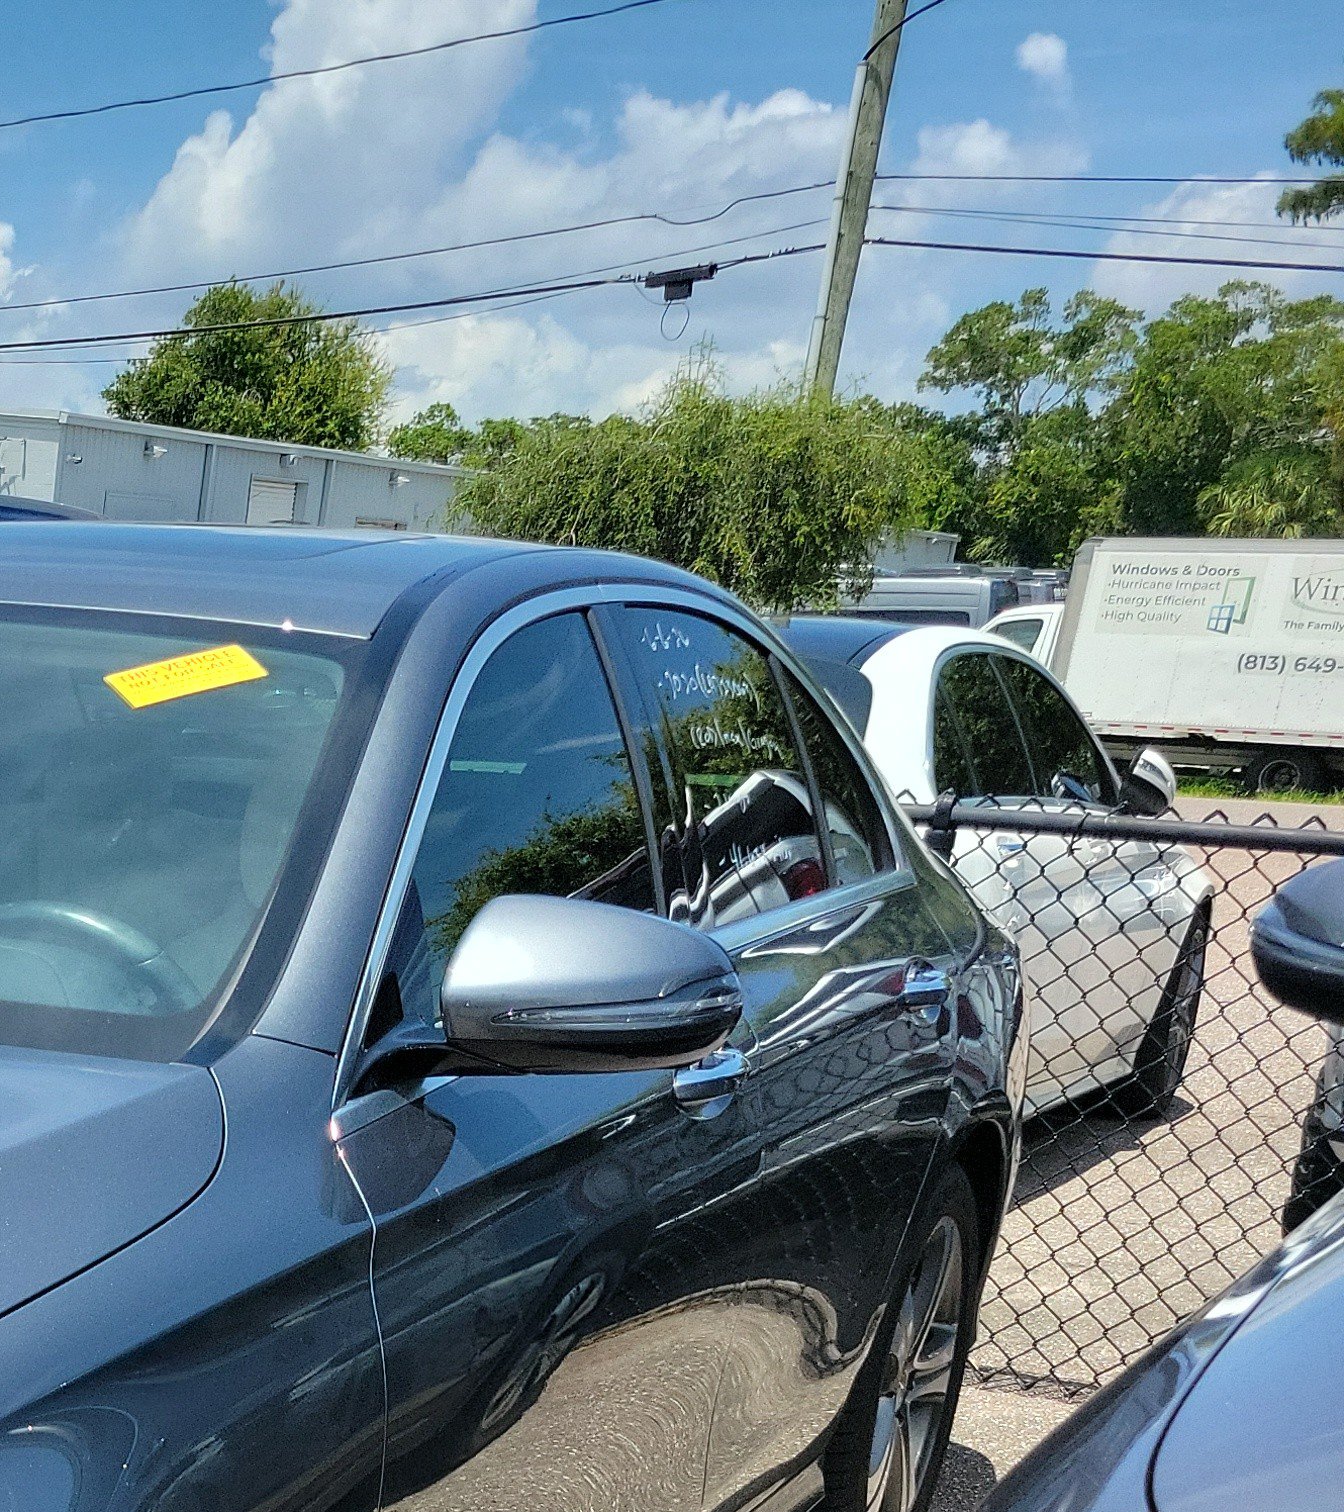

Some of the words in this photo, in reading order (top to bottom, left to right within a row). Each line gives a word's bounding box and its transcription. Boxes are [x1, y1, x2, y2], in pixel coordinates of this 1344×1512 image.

[1112, 563, 1179, 576] Windows
[1182, 564, 1192, 576] &
[1196, 563, 1241, 577] Doors
[1111, 578, 1173, 590] Hurricane
[1175, 579, 1221, 591] Impact
[1108, 594, 1152, 606] Energy
[1154, 595, 1206, 606] Efficient
[1104, 609, 1133, 622] High
[1137, 611, 1182, 624] Quality
[1283, 620, 1304, 629] The
[1307, 620, 1344, 632] Family
[160, 649, 236, 672] VEHICLE
[1237, 653, 1286, 675] (813)
[1294, 656, 1344, 673] 649-
